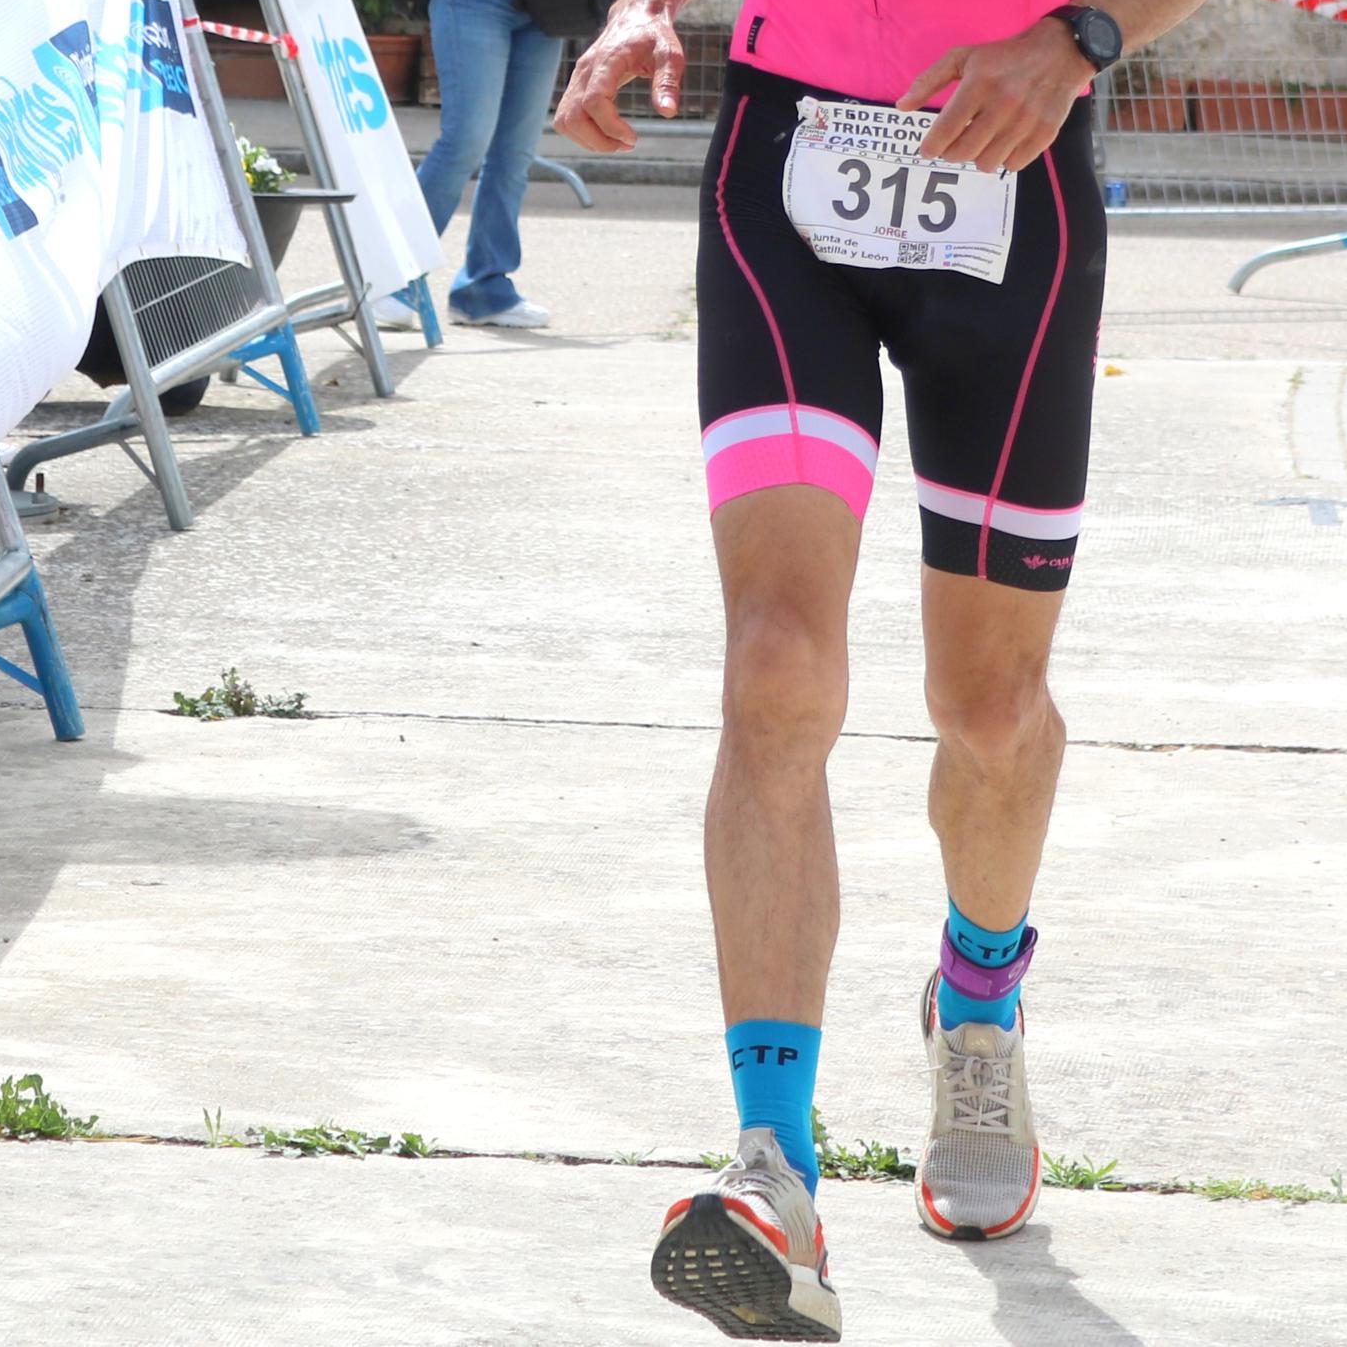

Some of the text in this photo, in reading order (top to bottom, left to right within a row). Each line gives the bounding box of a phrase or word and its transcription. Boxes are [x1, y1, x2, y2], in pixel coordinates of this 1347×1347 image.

[832, 122, 922, 142] TRIATLON
[831, 158, 960, 234] 315
[873, 226, 909, 239] JORGE
[844, 239, 859, 247] de
[860, 251, 890, 262] León
[958, 931, 1020, 960] CTP
[731, 1043, 799, 1071] CTP
